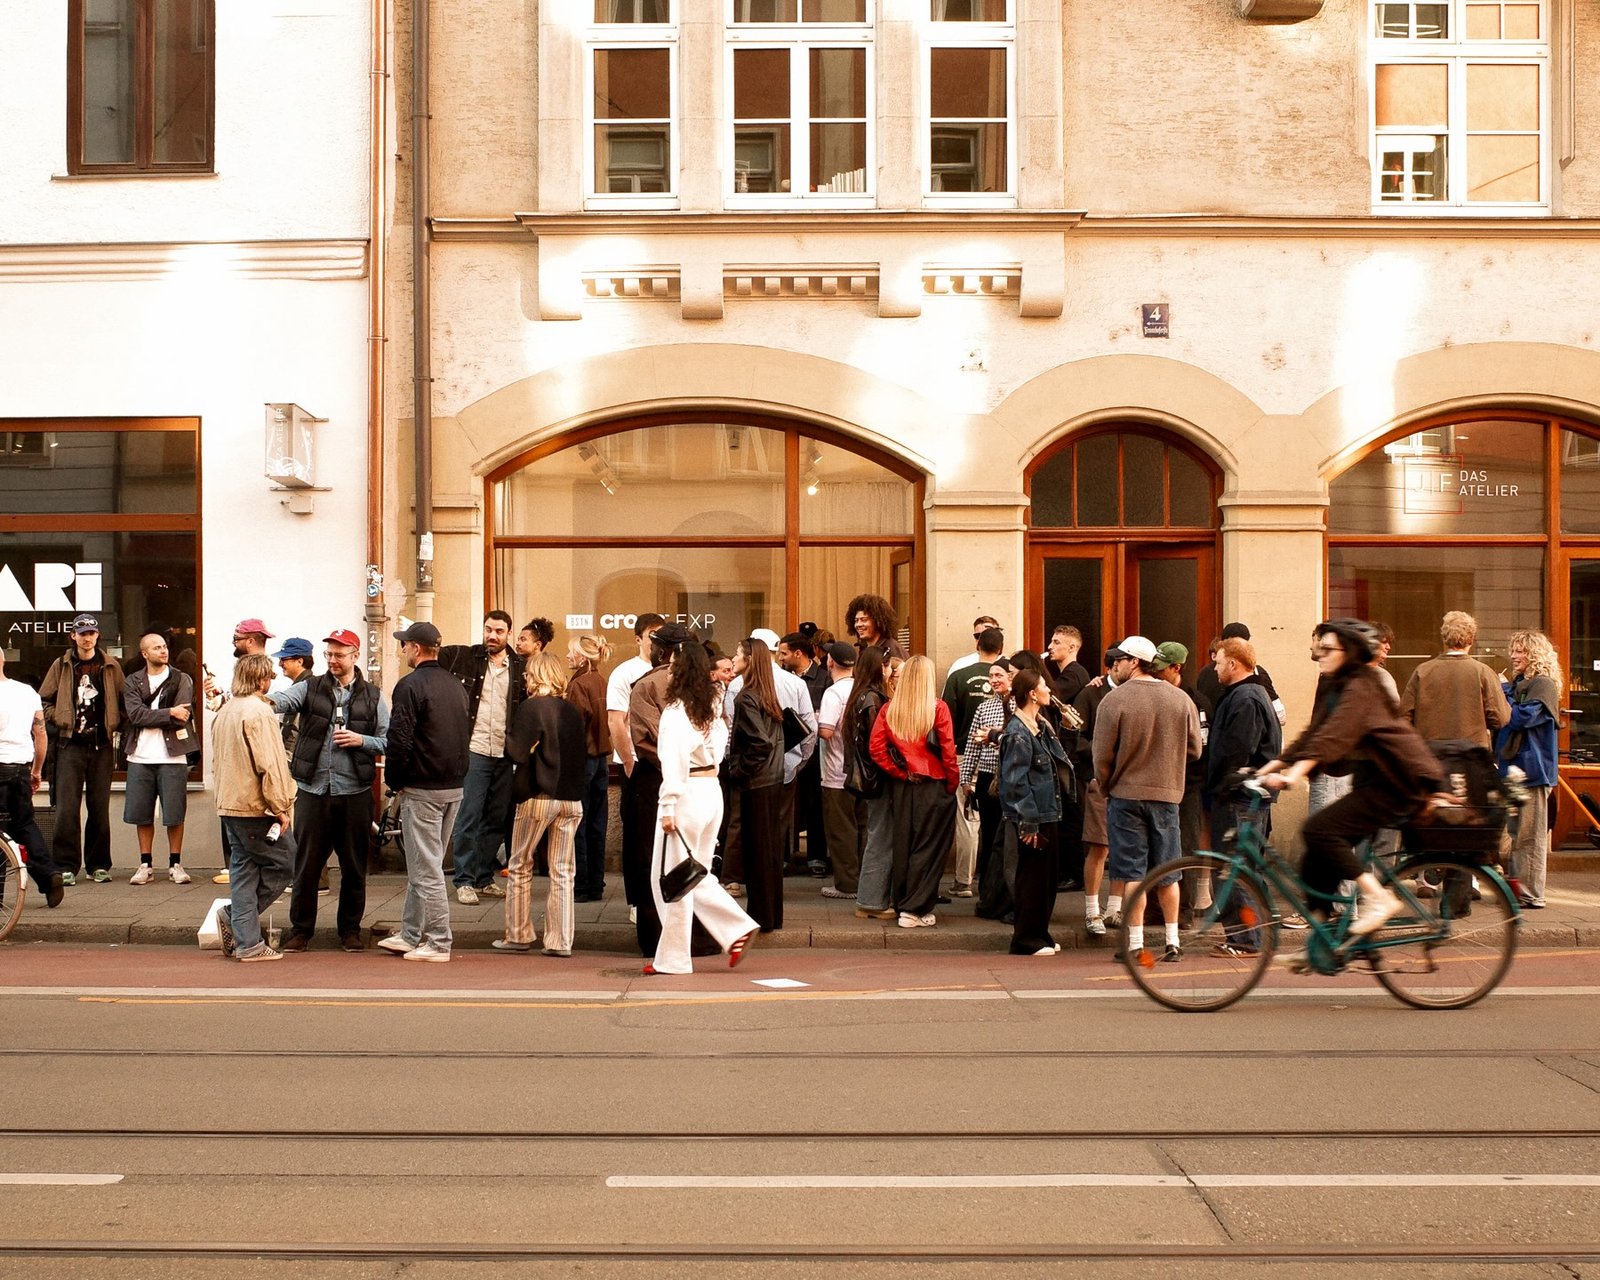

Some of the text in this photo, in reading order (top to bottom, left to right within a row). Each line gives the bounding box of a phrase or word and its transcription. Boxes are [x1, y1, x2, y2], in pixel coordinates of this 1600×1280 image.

[1149, 305, 1162, 321] 4
[1459, 470, 1488, 482] DAS
[1459, 484, 1519, 496] ATELIER
[8, 621, 74, 633] ATELIE
[675, 613, 716, 629] EXP
